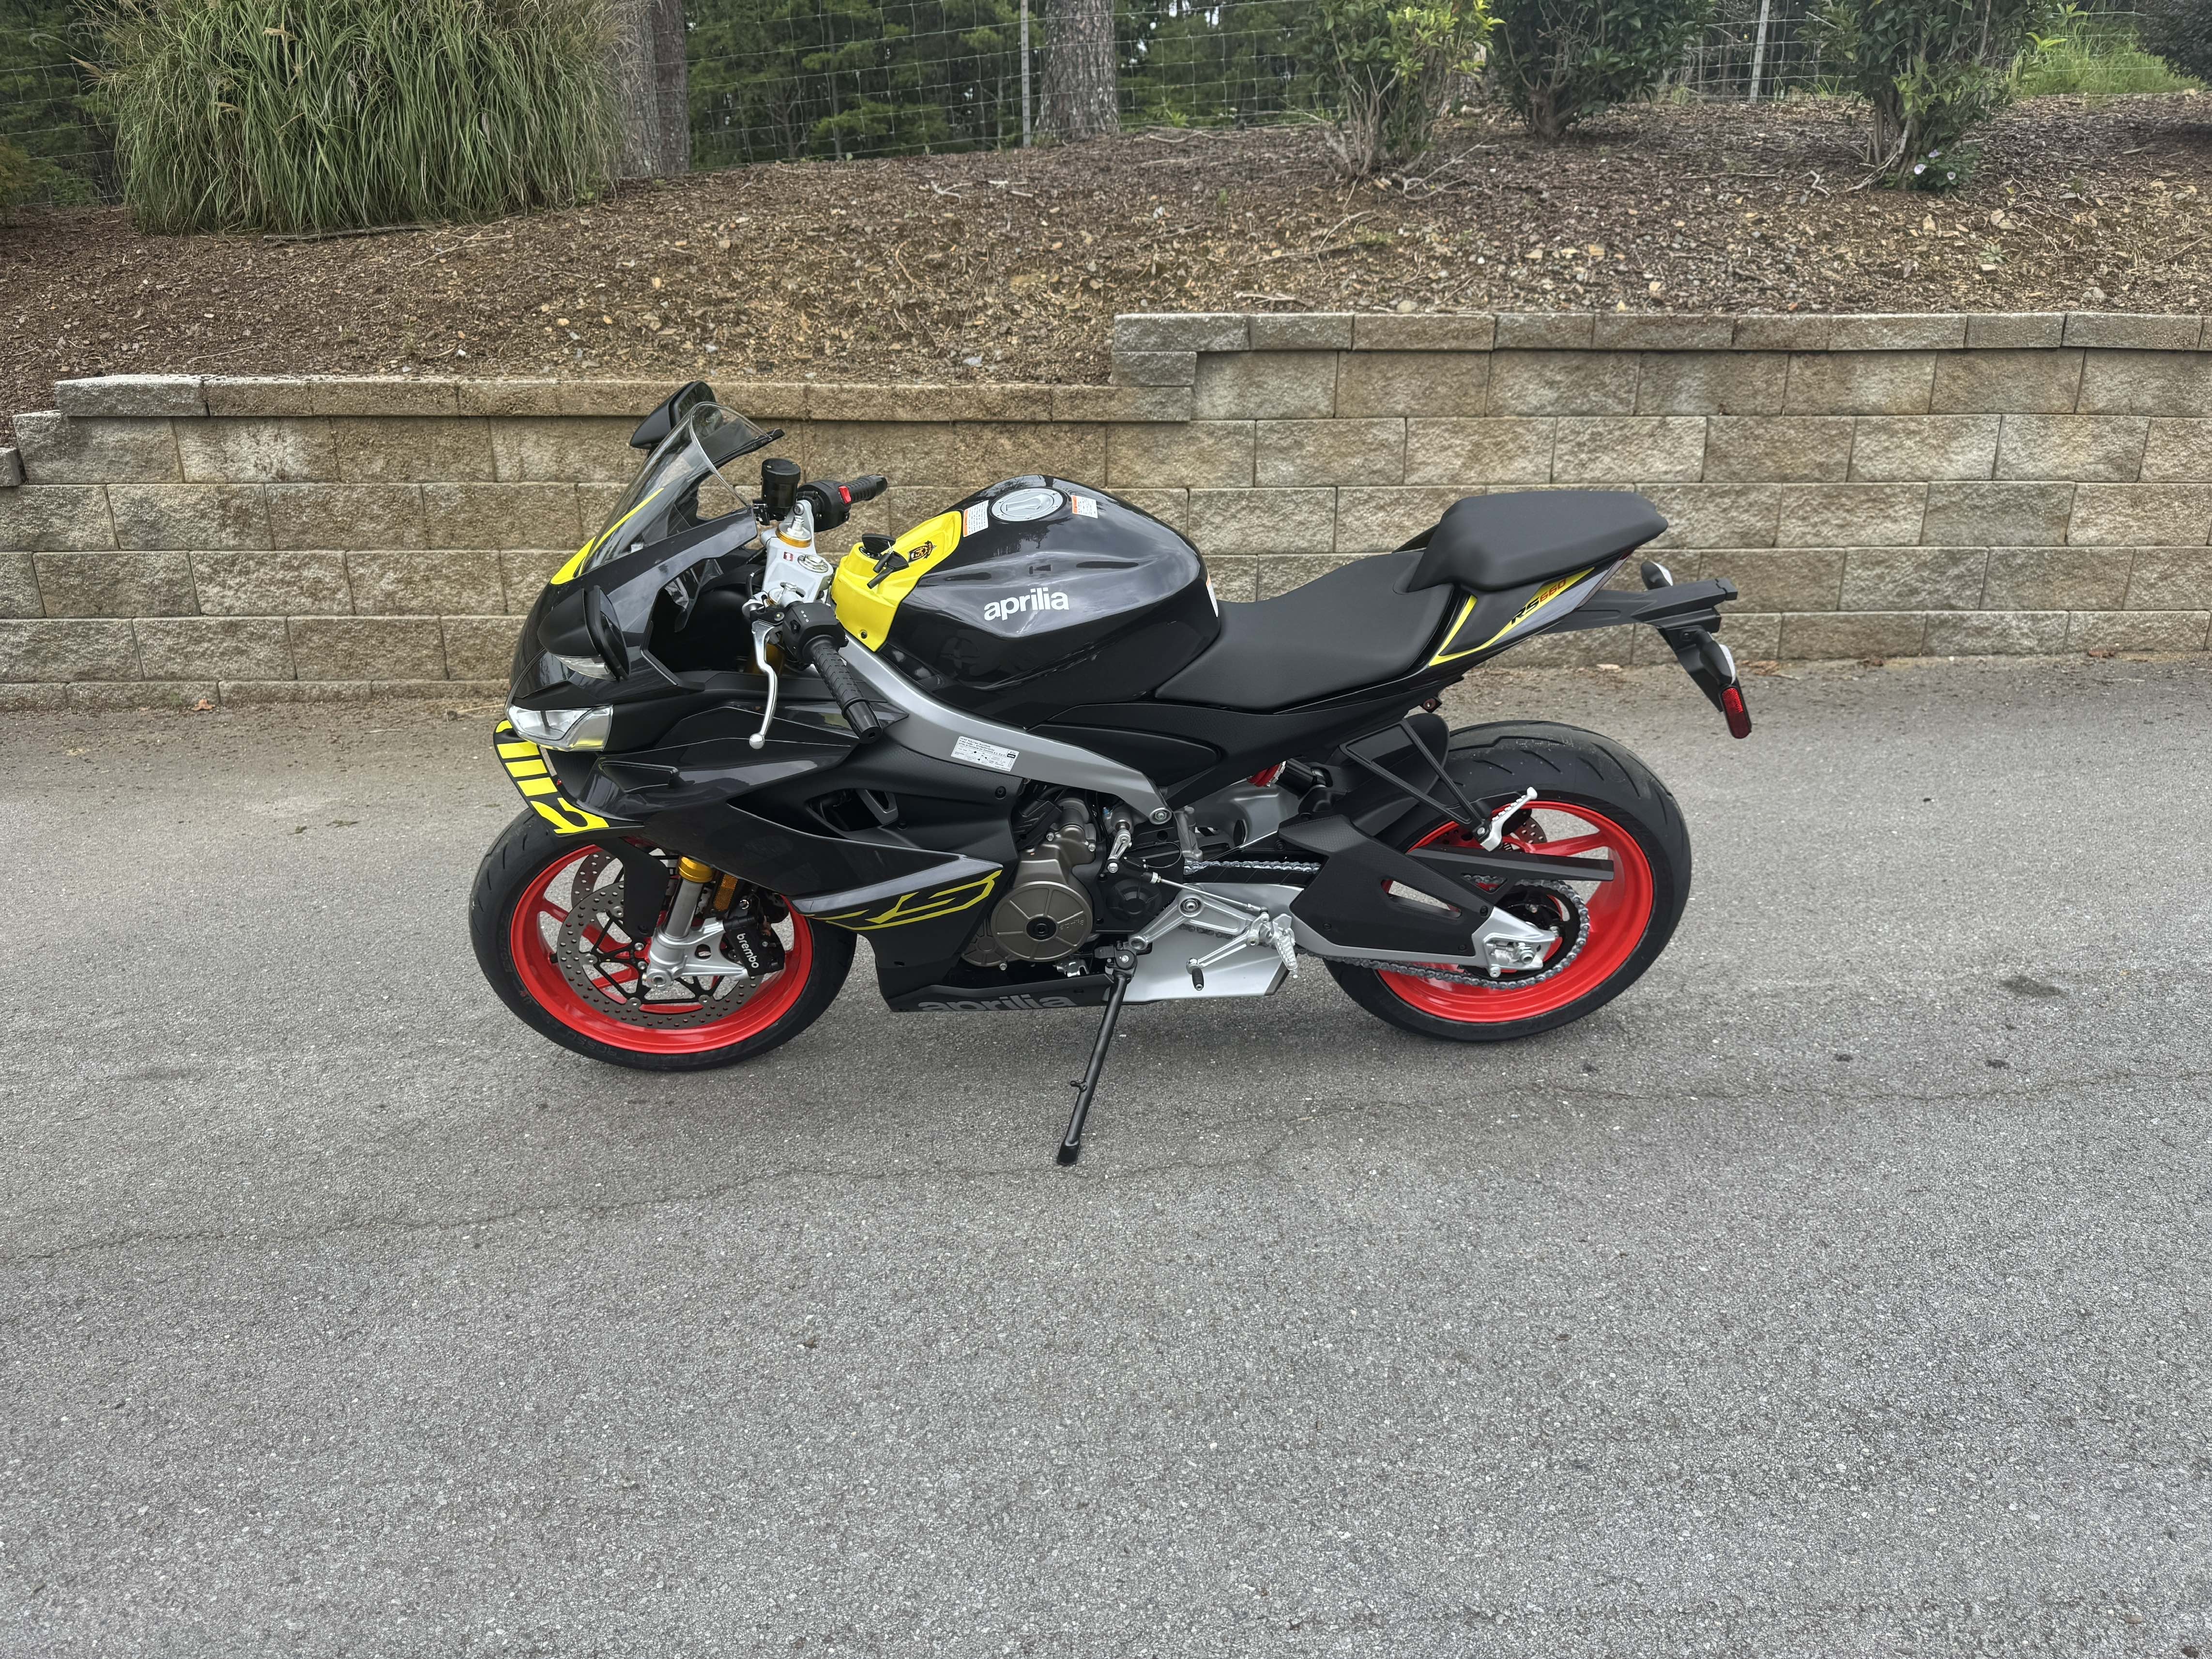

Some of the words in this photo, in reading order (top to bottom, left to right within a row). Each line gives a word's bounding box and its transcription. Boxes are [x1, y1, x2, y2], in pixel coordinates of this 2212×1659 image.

[984, 587, 1069, 621] aprilia
[736, 933, 759, 968] brembo
[918, 994, 1077, 1011] aprilia
